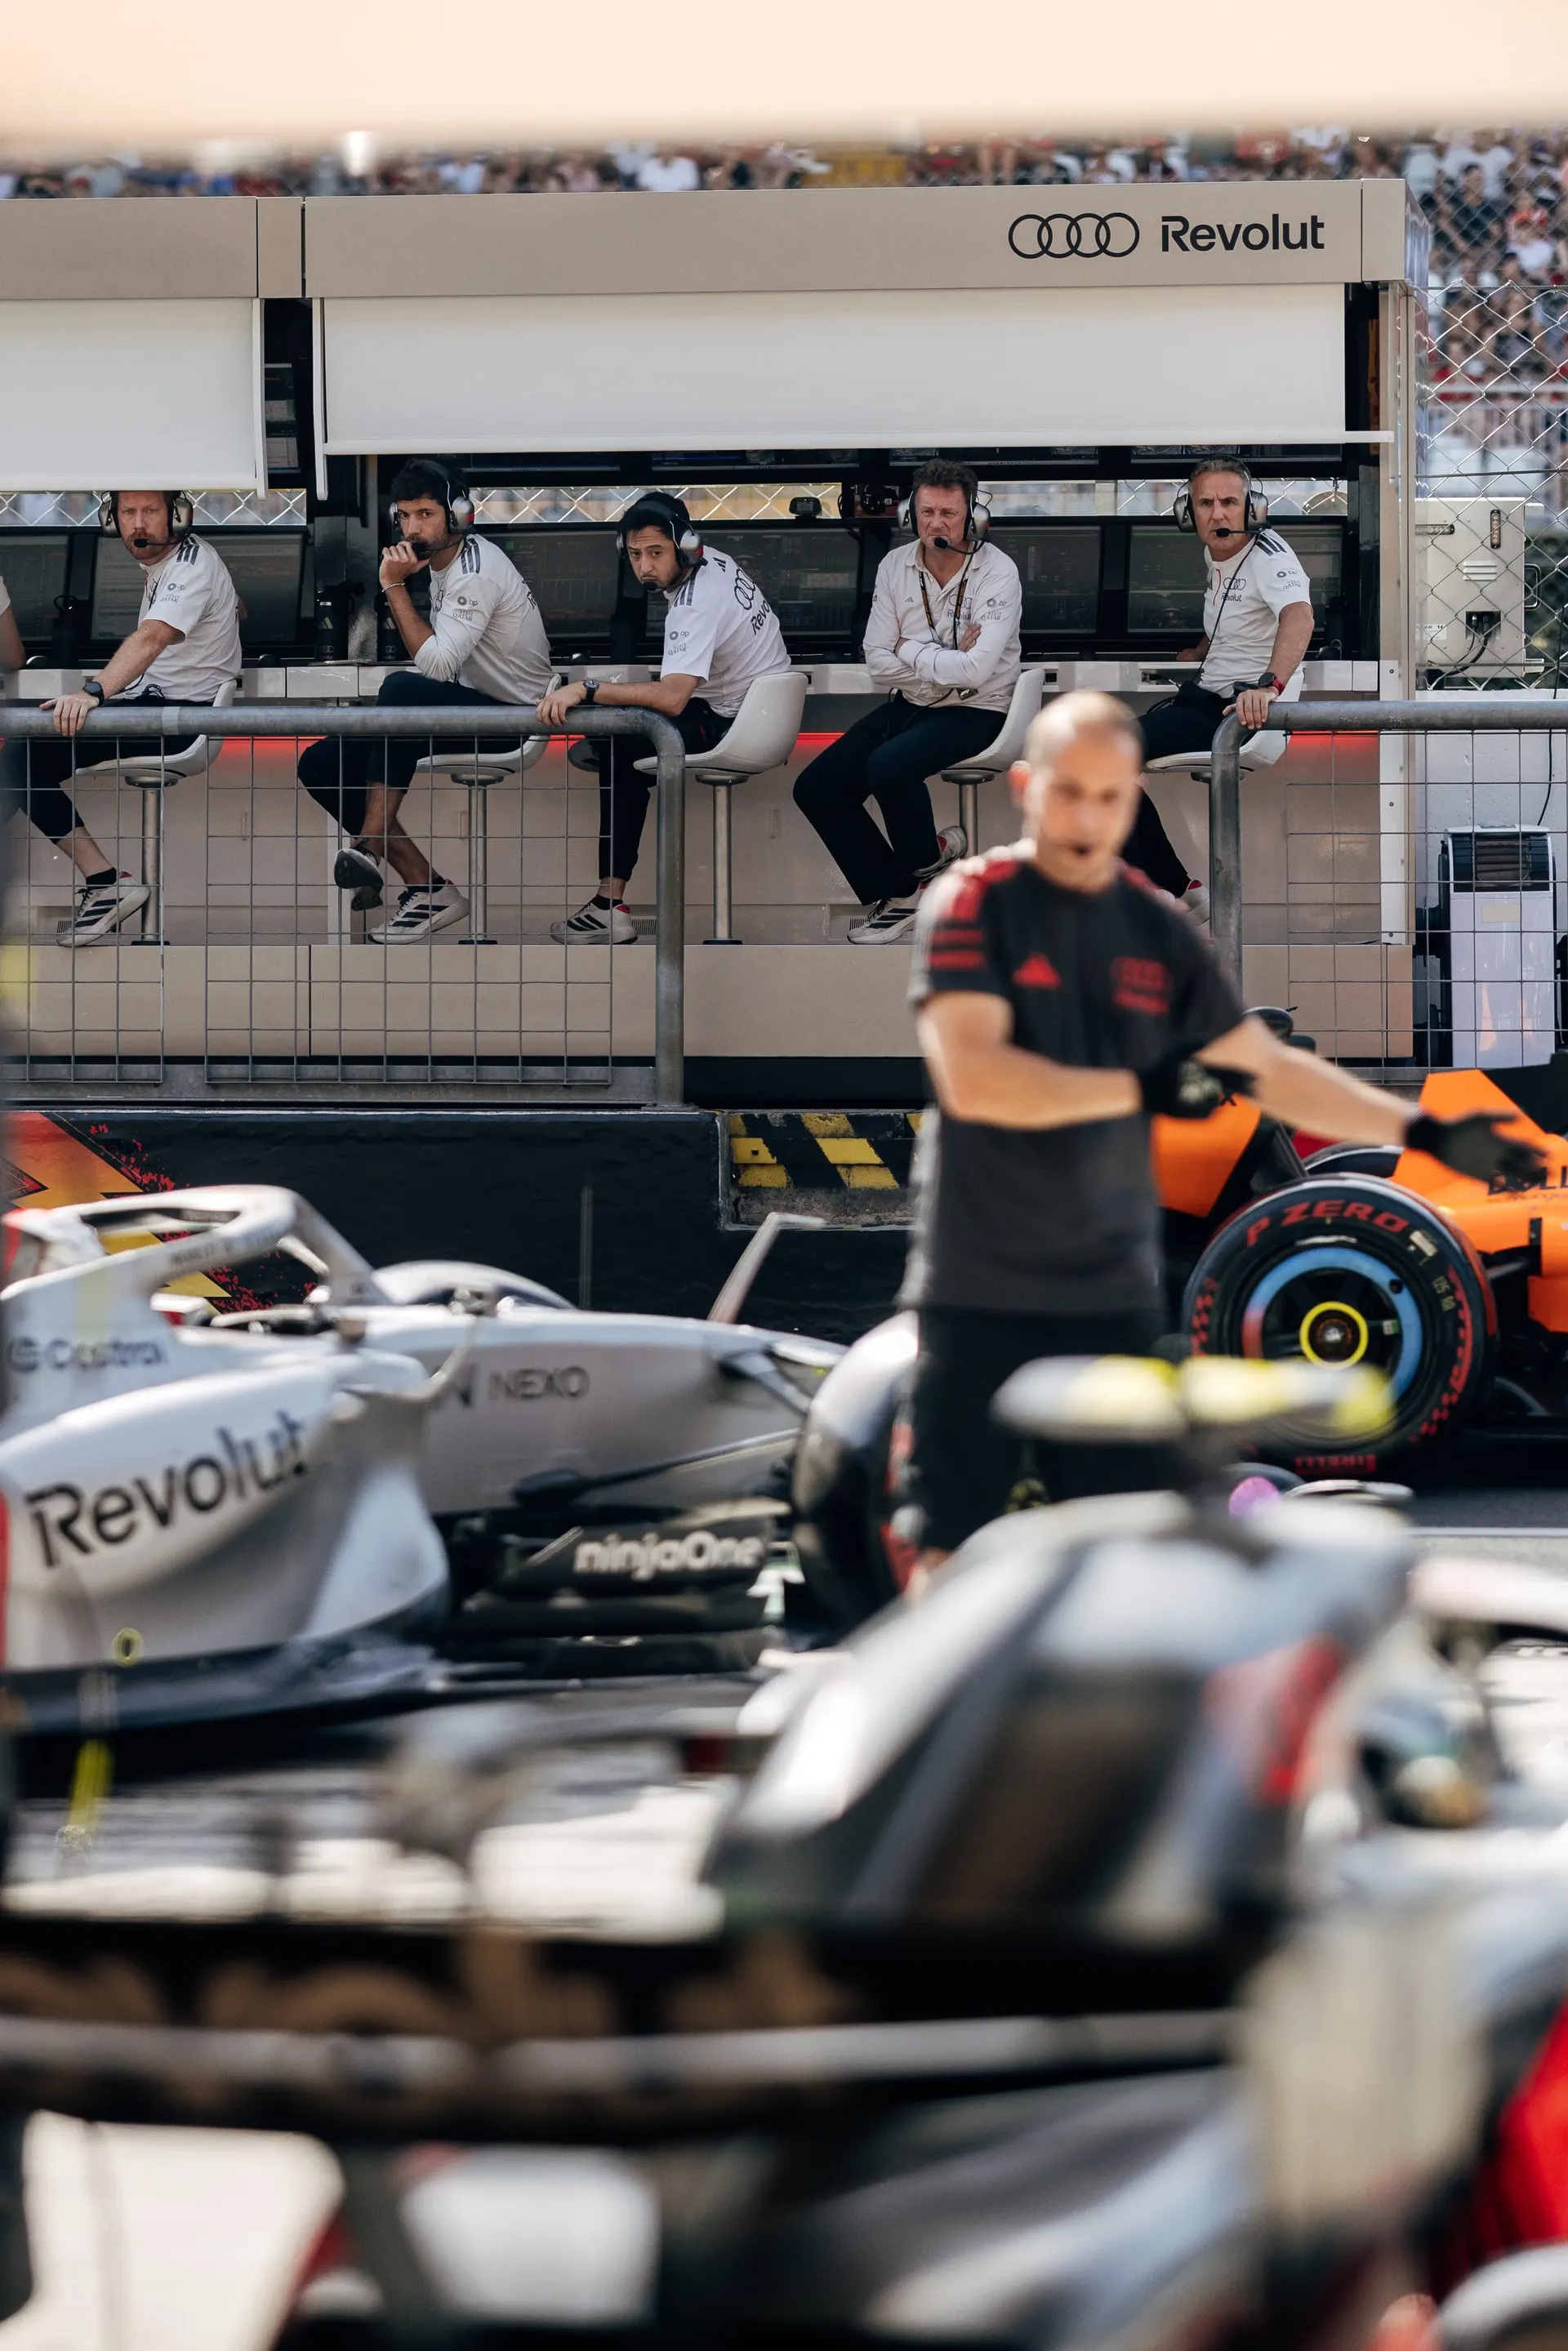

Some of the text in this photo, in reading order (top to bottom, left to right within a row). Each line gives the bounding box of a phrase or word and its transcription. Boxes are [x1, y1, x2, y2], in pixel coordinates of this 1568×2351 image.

[1161, 213, 1325, 253] Revolut
[469, 598, 478, 608] bp
[947, 608, 972, 621] Rolu
[1245, 1199, 1410, 1248] P ZERO
[24, 1408, 305, 1568] Revolut
[573, 1529, 766, 1582] ninjaOne
